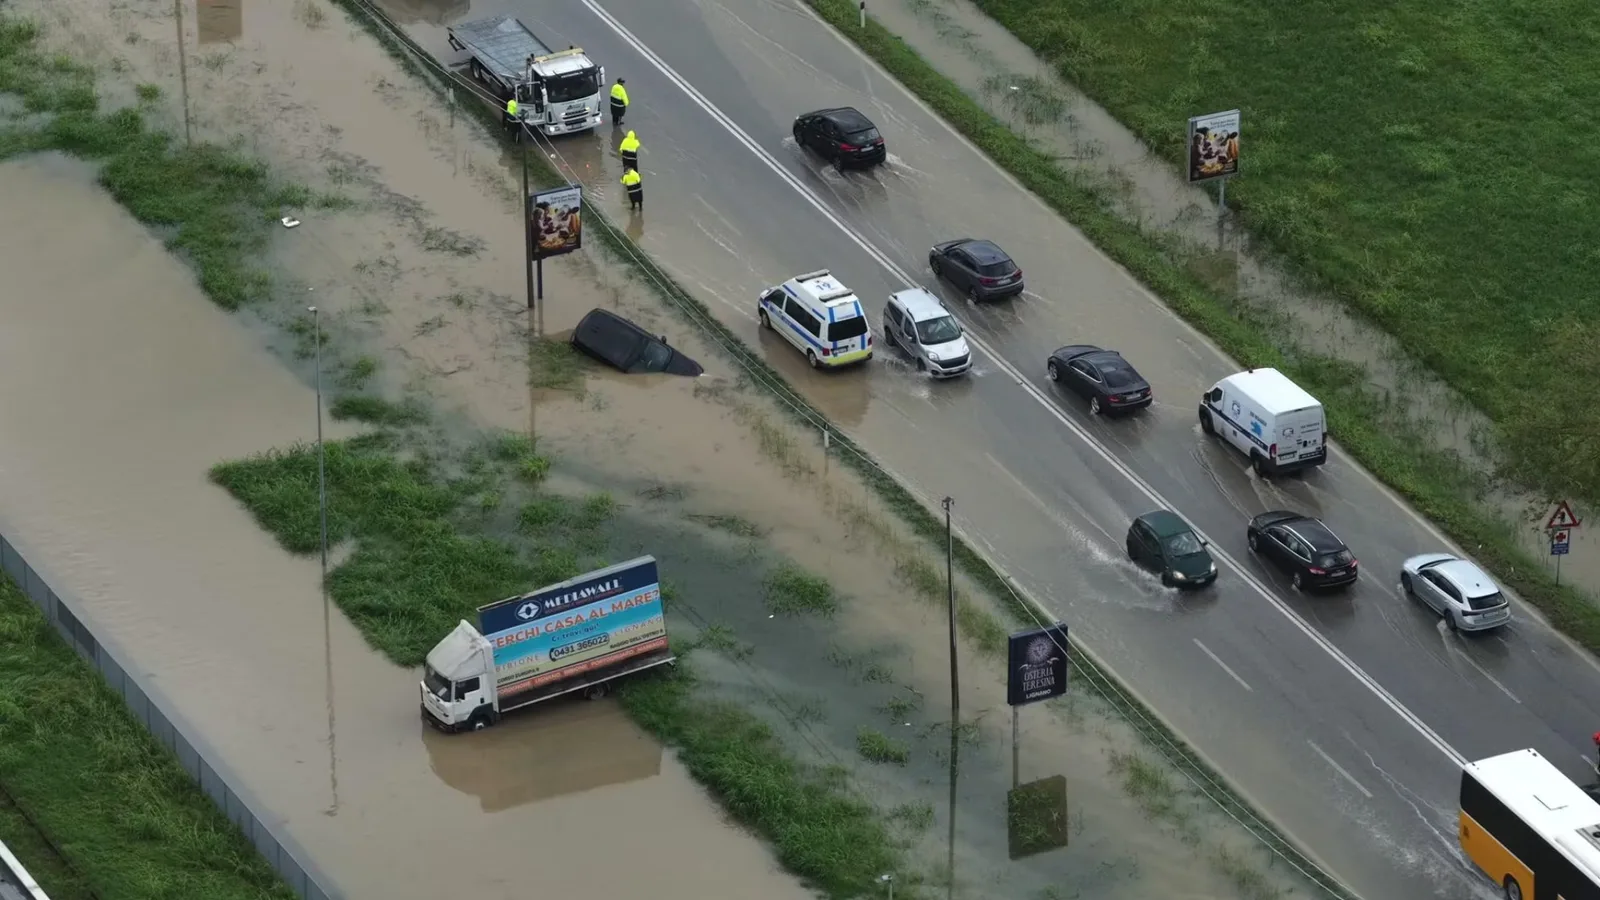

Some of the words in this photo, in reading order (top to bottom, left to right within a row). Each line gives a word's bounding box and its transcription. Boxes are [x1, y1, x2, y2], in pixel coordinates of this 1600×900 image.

[544, 579, 623, 609] MEDIAWALL
[544, 613, 585, 633] CASA
[590, 607, 608, 619] AL
[611, 589, 659, 613] MARE?
[611, 616, 662, 638] LIGNANO
[554, 644, 575, 657] 0431
[577, 635, 608, 650] 365022
[496, 653, 539, 673] BIBIONE
[497, 675, 515, 684] CORSO
[1023, 676, 1055, 692] TERESINA
[1024, 667, 1053, 681] OSTERIA
[1026, 689, 1051, 699] LIGNANO
